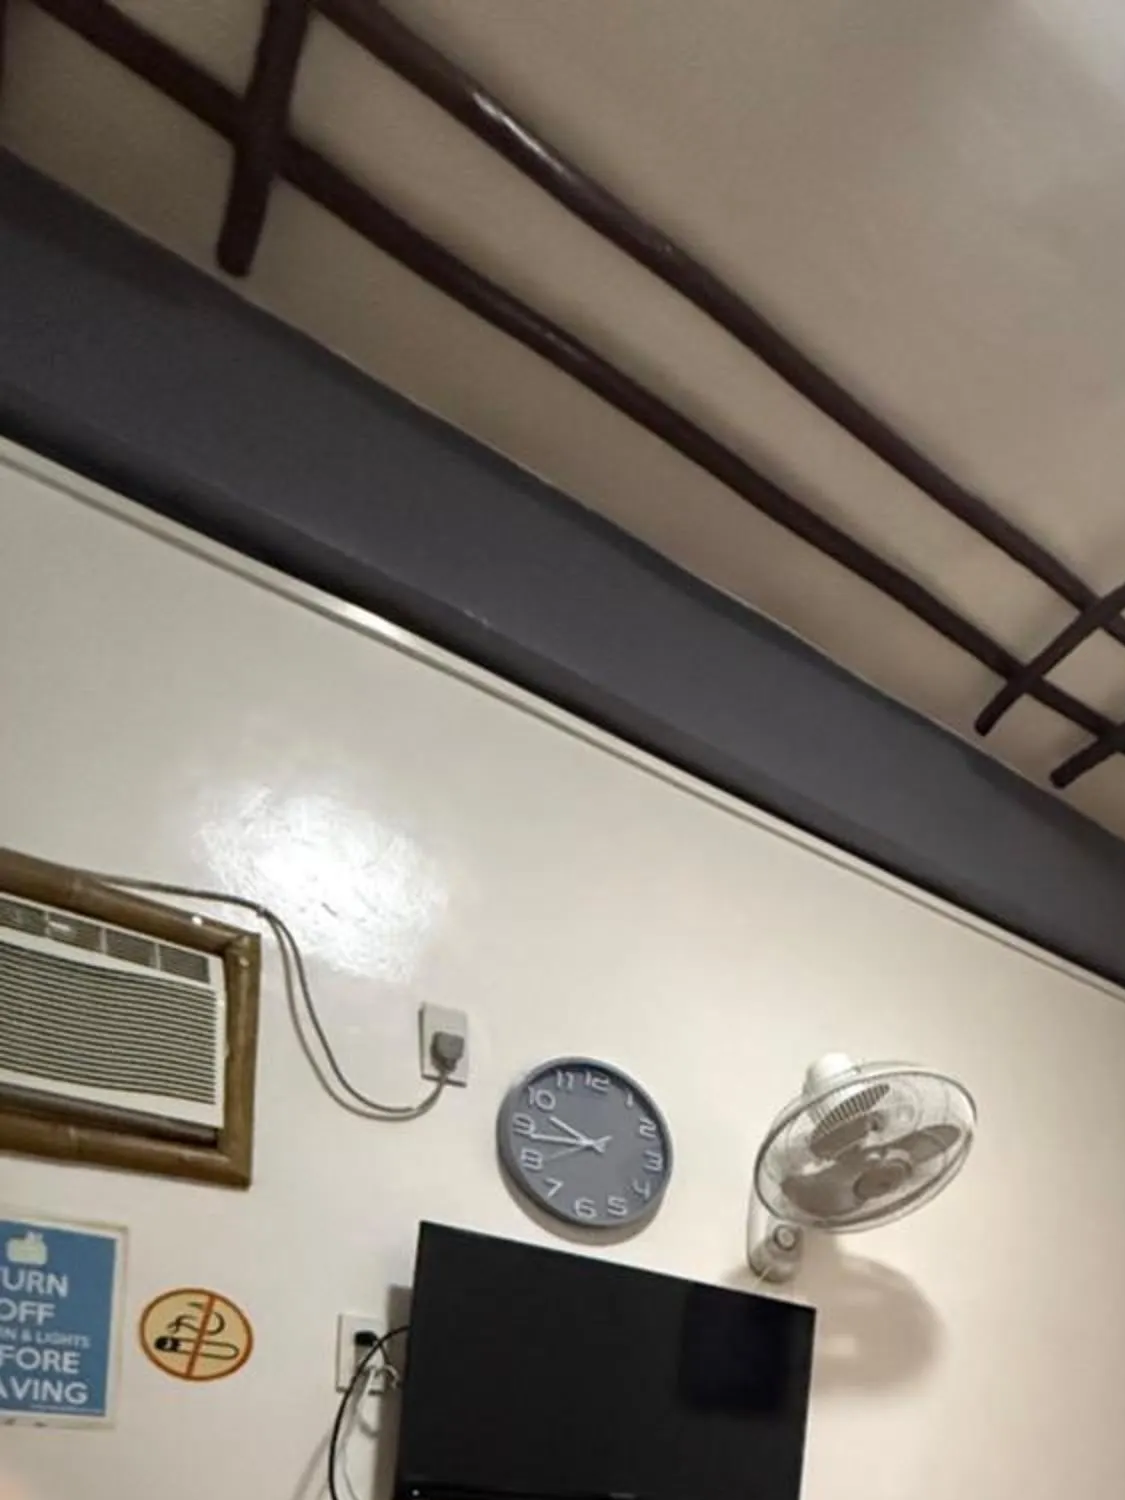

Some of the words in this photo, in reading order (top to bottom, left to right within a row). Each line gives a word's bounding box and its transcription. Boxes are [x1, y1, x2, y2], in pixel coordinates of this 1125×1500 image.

[556, 1071, 575, 1089] 11
[584, 1071, 609, 1092] 12
[528, 1087, 556, 1111] 10
[626, 1093, 634, 1107] 1
[513, 1113, 535, 1136] 9
[639, 1117, 657, 1138] 2
[520, 1148, 543, 1171] 8
[643, 1150, 663, 1172] 3
[545, 1177, 564, 1197] 7
[632, 1179, 650, 1199] 4
[574, 1198, 597, 1218] 6
[608, 1195, 628, 1216] 5
[0, 1297, 56, 1326] OFF
